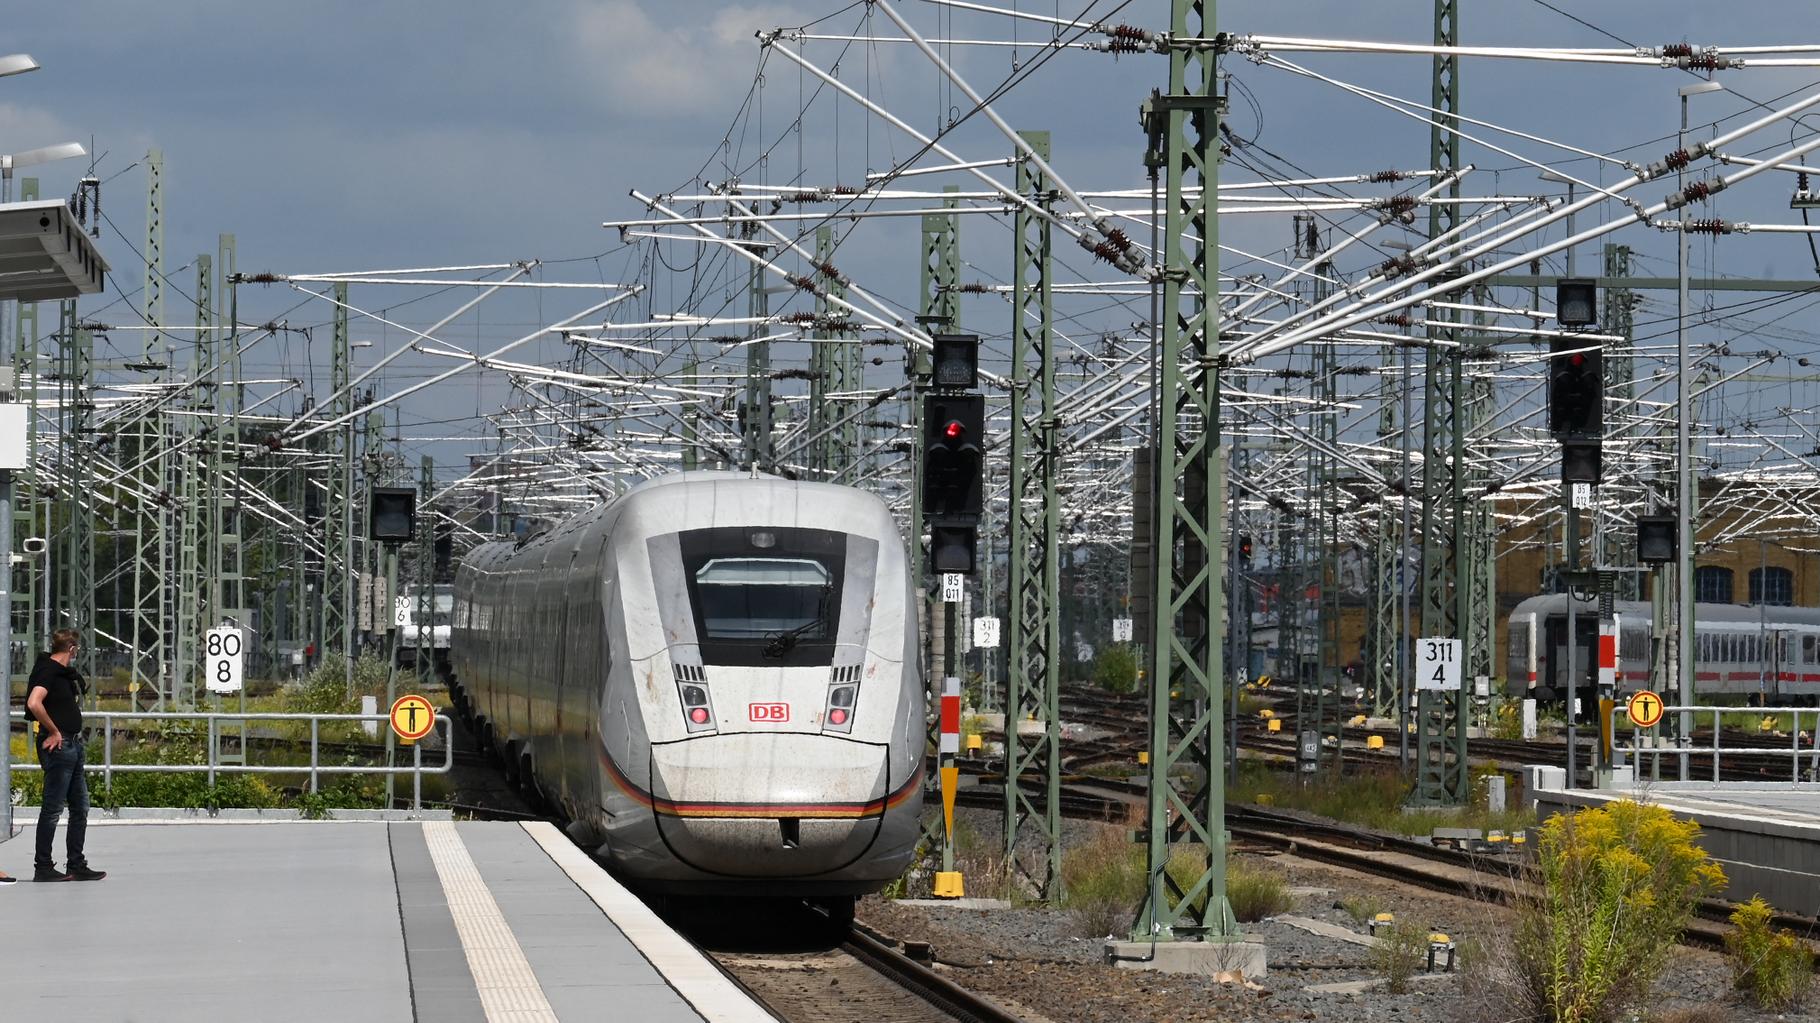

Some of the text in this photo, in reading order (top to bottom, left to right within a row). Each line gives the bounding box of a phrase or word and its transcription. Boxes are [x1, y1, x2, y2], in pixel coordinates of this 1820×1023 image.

[947, 575, 959, 586] 85
[397, 609, 406, 622] 6
[208, 634, 242, 656] 80
[983, 632, 991, 644] 2
[1425, 642, 1453, 663] 311
[216, 659, 231, 683] 8
[1431, 663, 1446, 685] 4
[754, 705, 785, 719] DB
